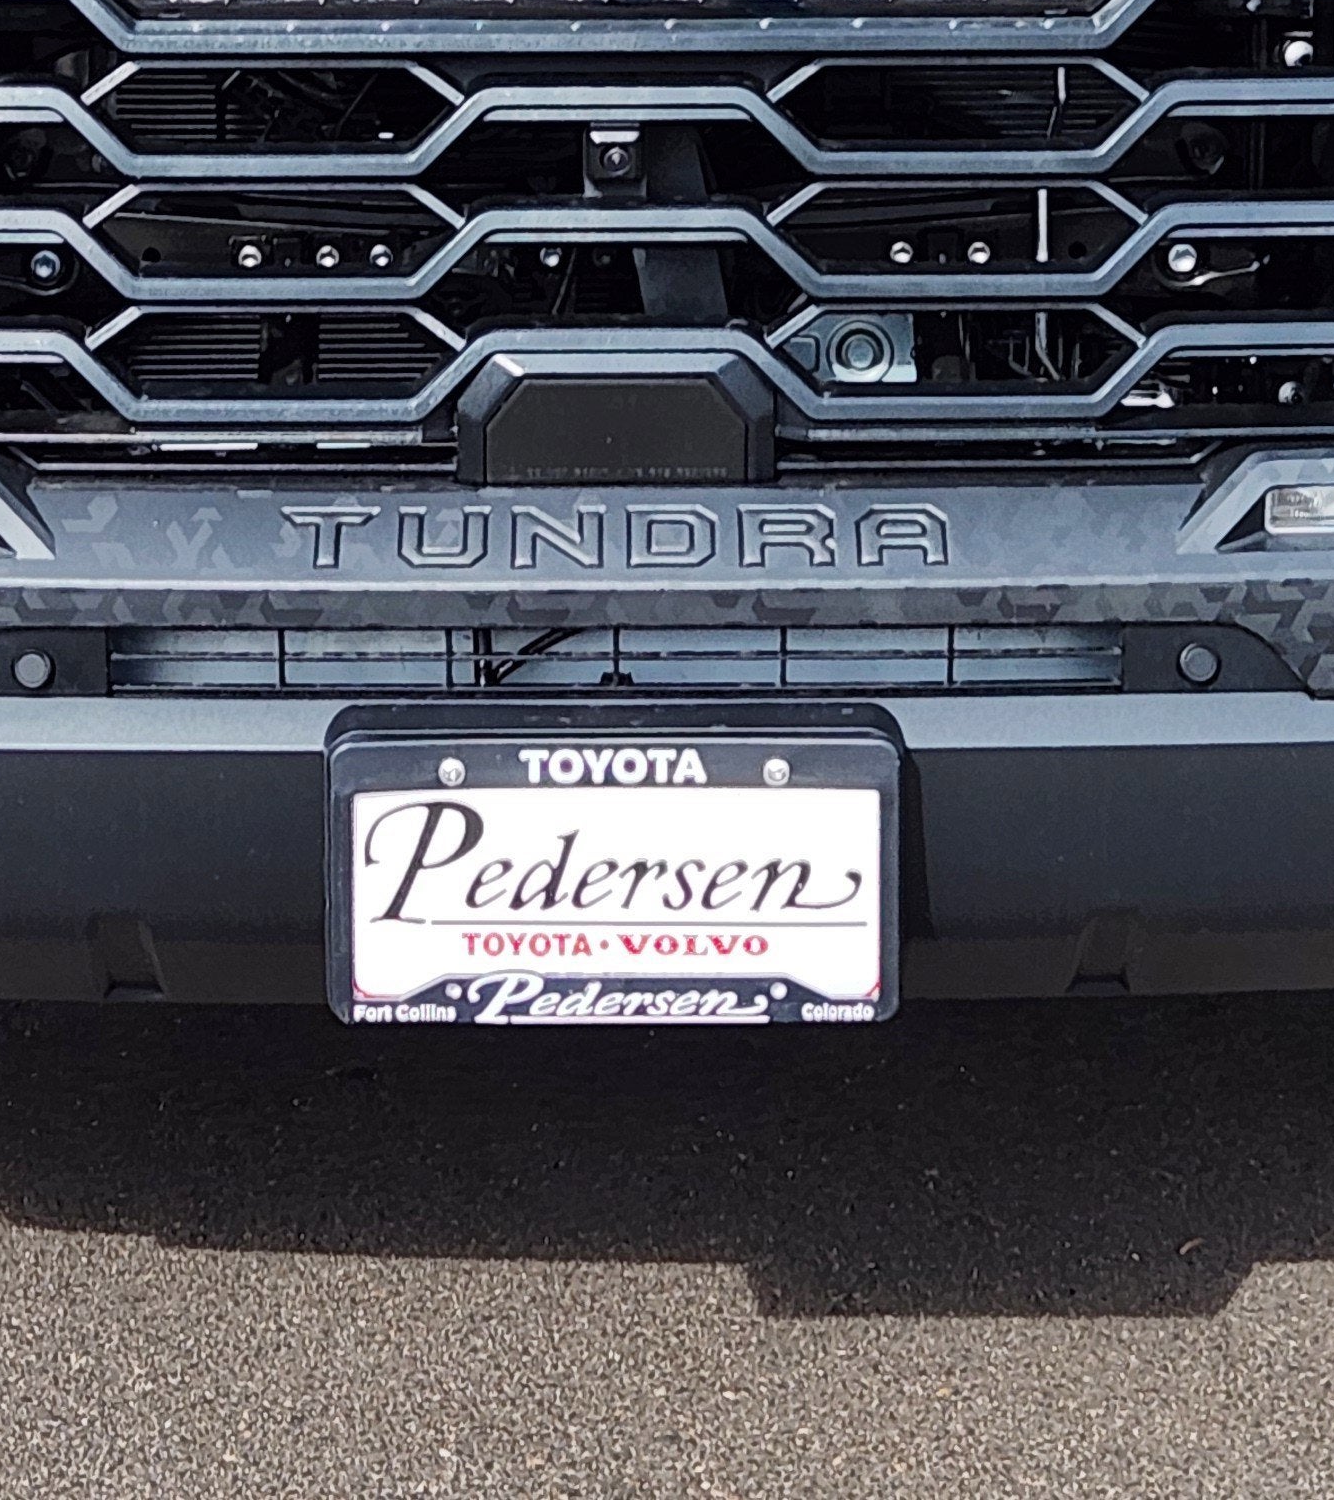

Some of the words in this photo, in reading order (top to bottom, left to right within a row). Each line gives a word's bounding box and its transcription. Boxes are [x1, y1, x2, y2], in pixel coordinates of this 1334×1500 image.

[280, 503, 949, 569] TUNDRA
[518, 748, 707, 785] TOYOTA
[364, 800, 862, 923] Pedersen
[461, 932, 593, 957] TOYOTA
[616, 933, 769, 956] VOLVO
[353, 1004, 393, 1023] Fort
[395, 1003, 457, 1023] Collins
[466, 971, 769, 1024] Pedersen
[801, 1002, 875, 1022] Colorado
